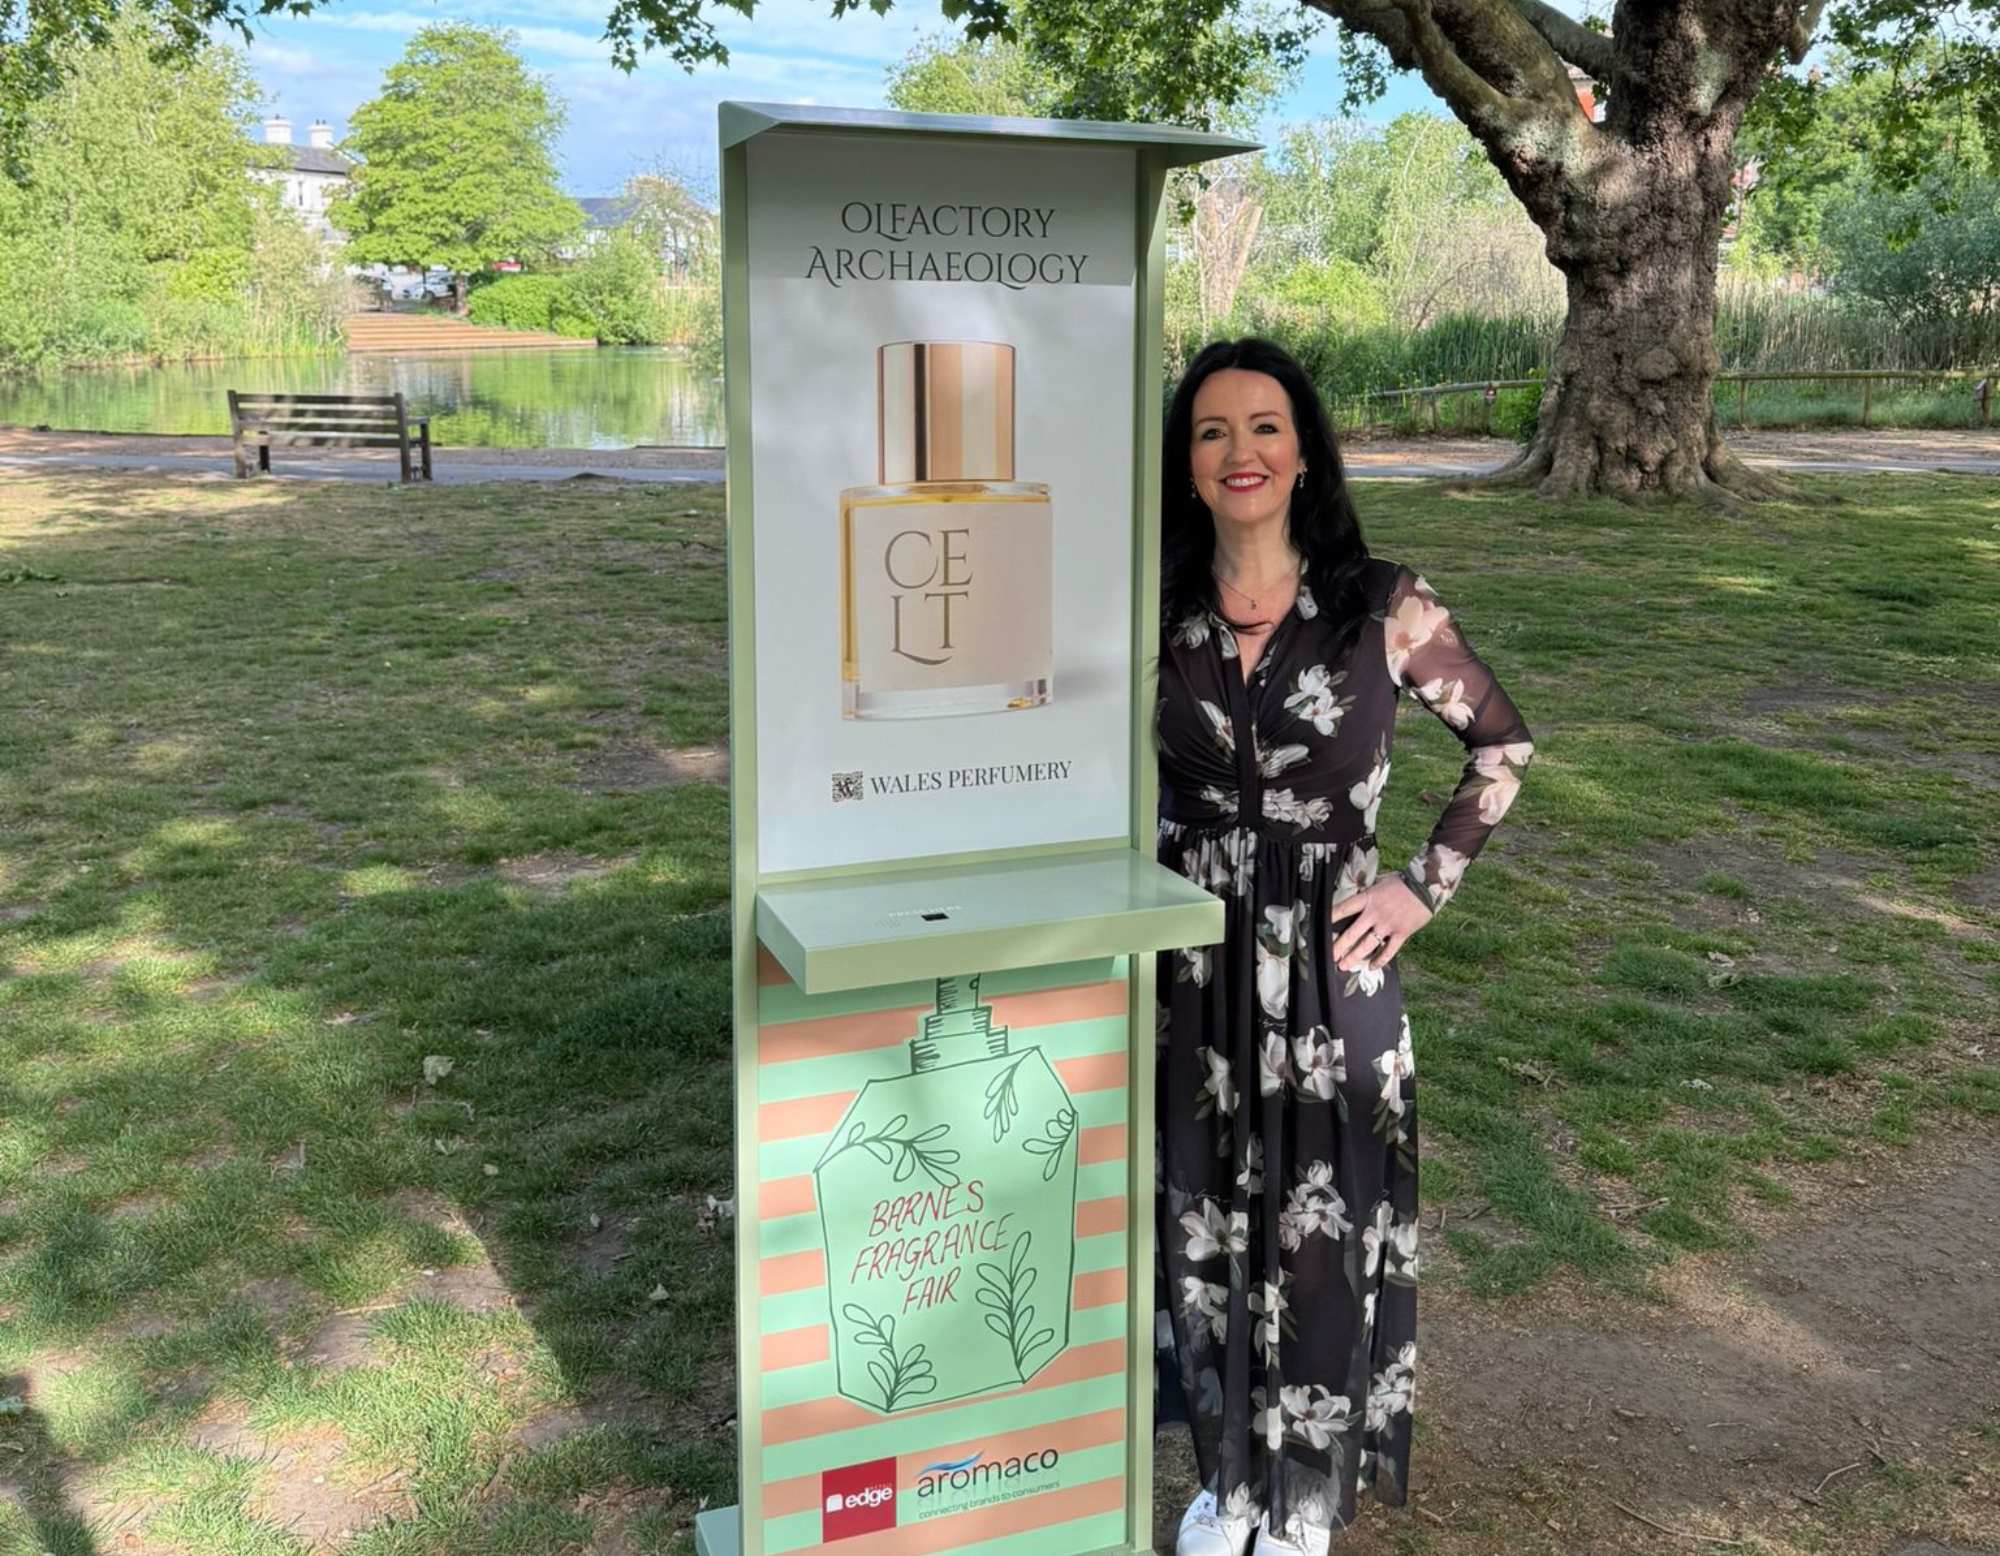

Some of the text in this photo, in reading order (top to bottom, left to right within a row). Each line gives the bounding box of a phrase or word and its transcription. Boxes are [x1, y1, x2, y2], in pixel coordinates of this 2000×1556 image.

[841, 201, 1056, 242] OLFACTORY
[804, 246, 1089, 290] ARCHAEOLOGY
[870, 760, 1072, 795] WALES PERFUMERY
[868, 1180, 984, 1237] BARNES
[850, 1212, 1015, 1284] FRAGRANCE
[902, 1266, 961, 1315] FAIR
[917, 1448, 1059, 1498] aromaco
[845, 1487, 893, 1508] edge
